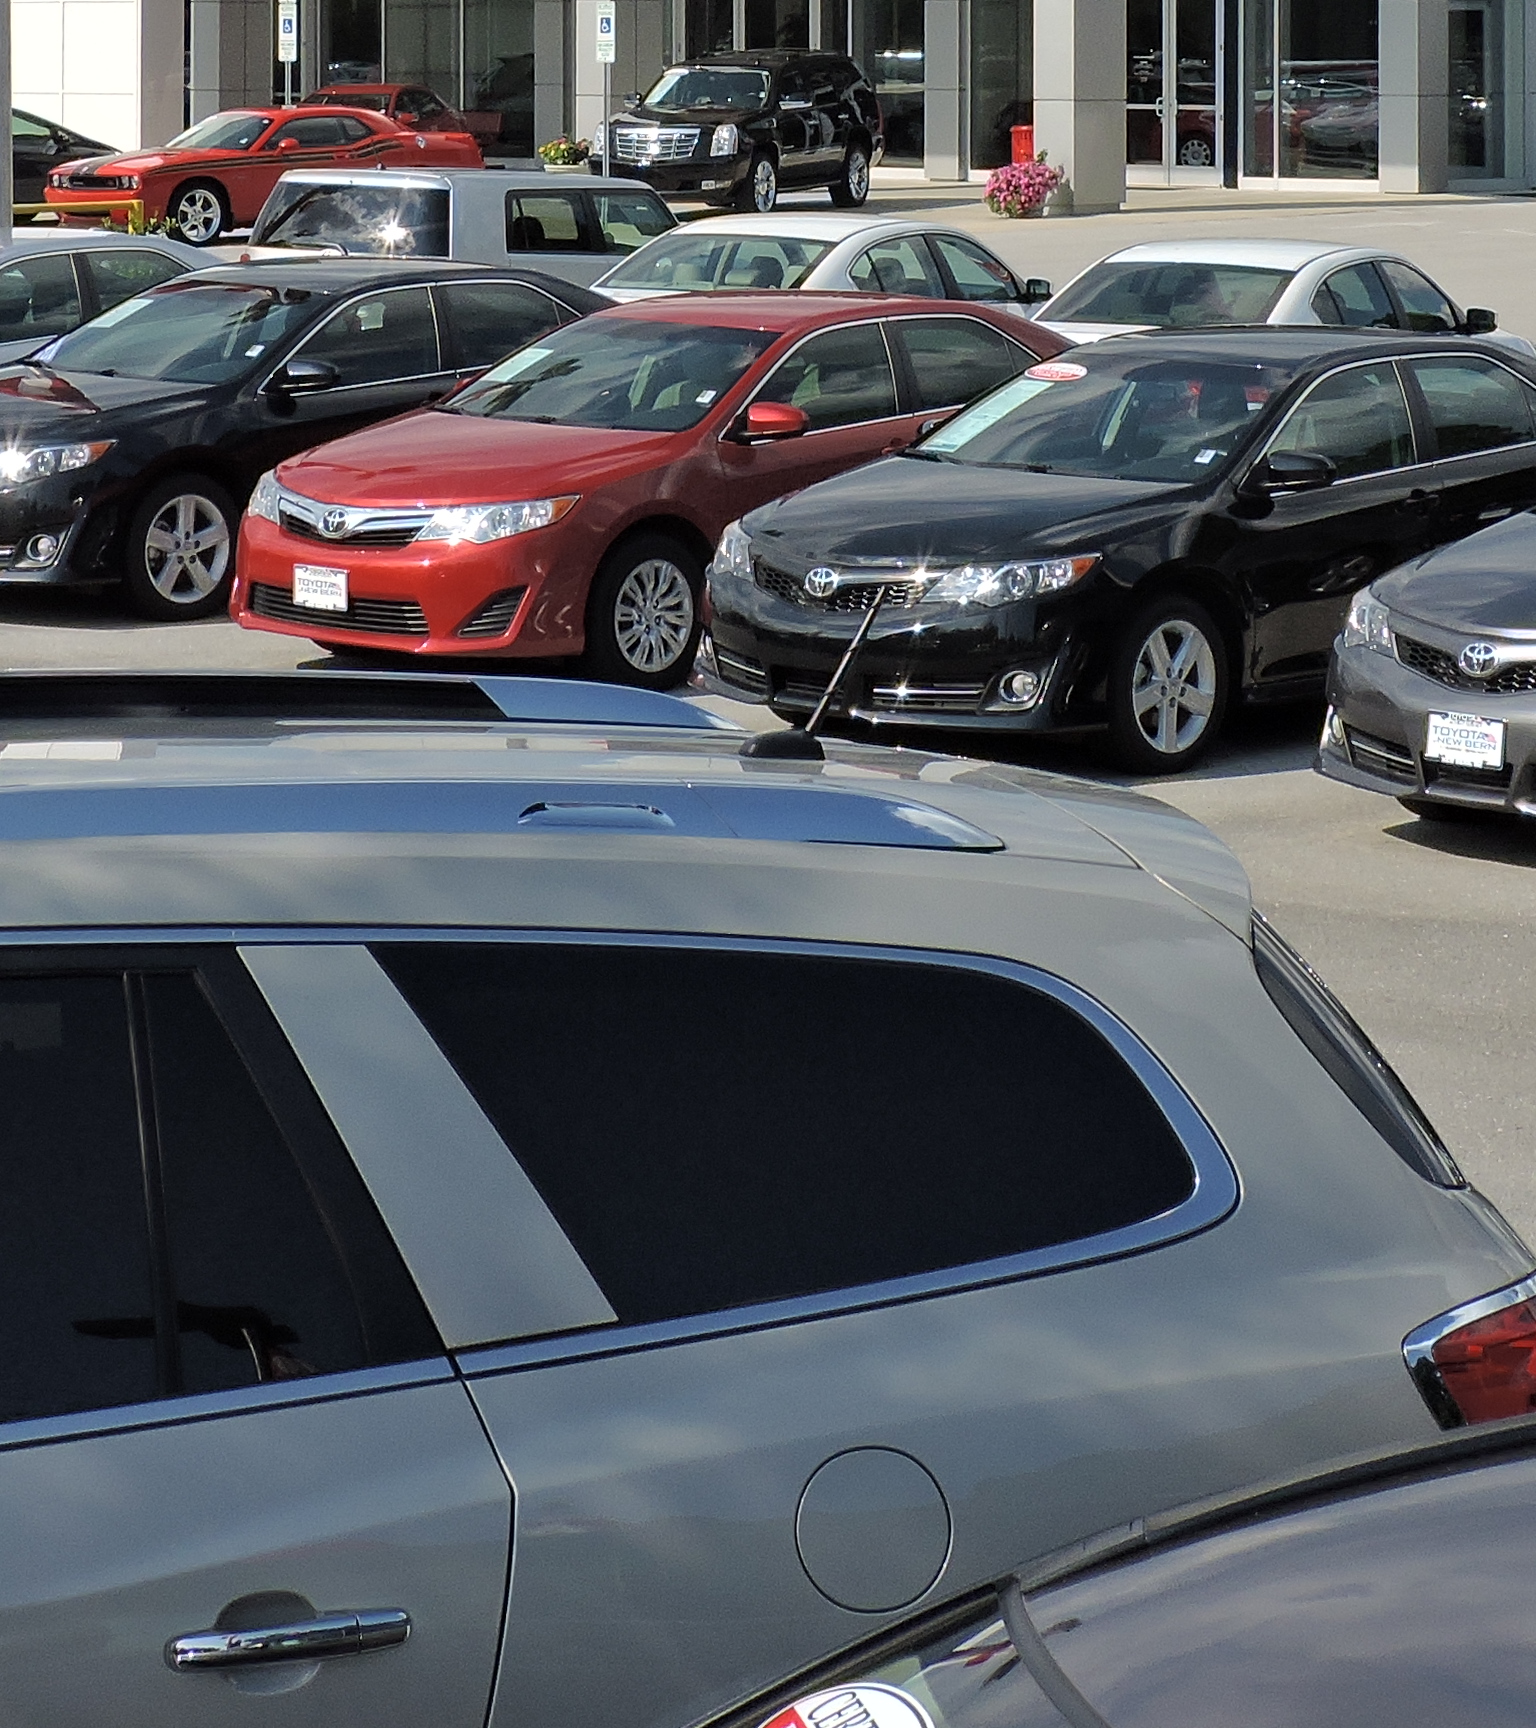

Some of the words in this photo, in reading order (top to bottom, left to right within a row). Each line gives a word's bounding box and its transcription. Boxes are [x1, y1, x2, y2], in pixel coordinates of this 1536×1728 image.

[297, 577, 337, 589] TOYOTA
[1432, 725, 1487, 741] TOYOTA
[1437, 736, 1463, 746] NEW
[1464, 740, 1497, 751] BERN
